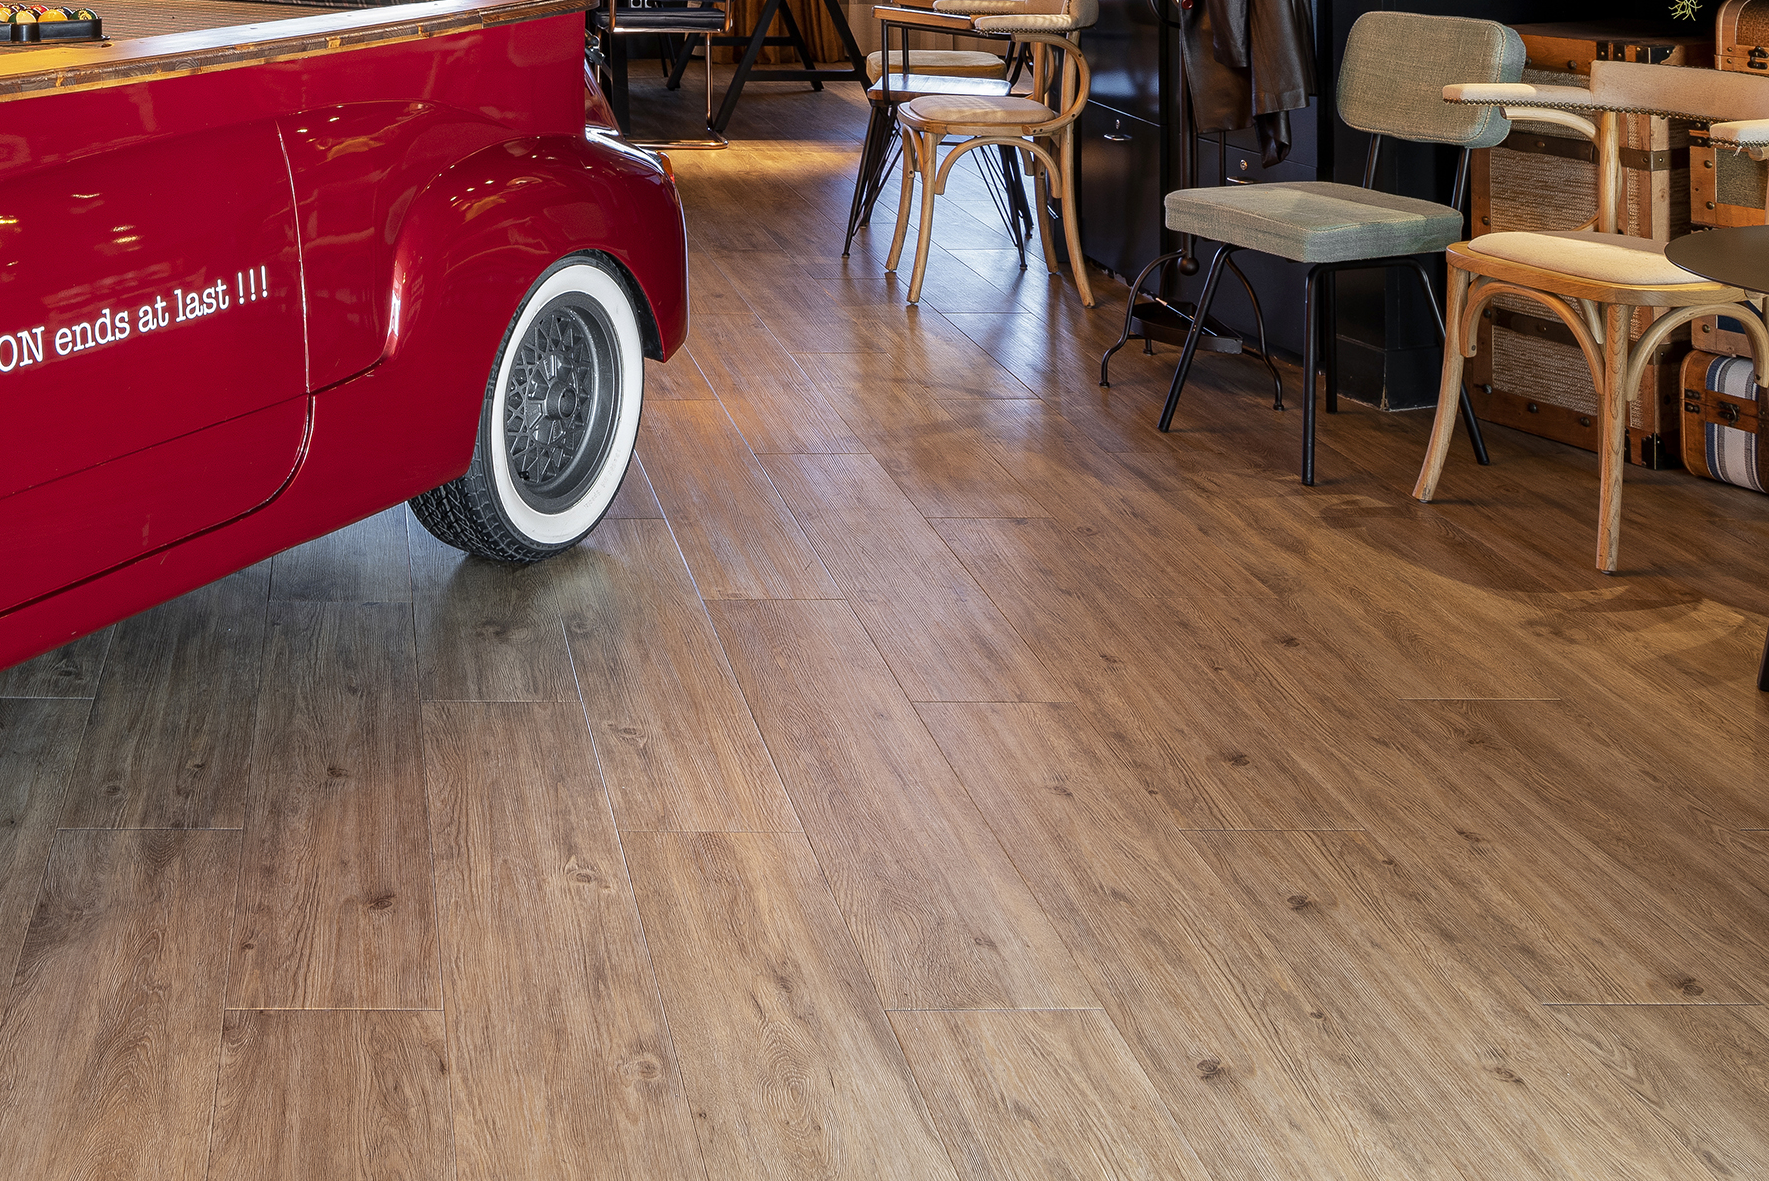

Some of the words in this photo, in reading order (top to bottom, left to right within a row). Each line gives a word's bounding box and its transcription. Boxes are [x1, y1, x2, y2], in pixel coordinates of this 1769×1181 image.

[54, 308, 132, 357] ends
[136, 294, 170, 334] at
[174, 278, 229, 324] last
[237, 264, 270, 305] !!!
